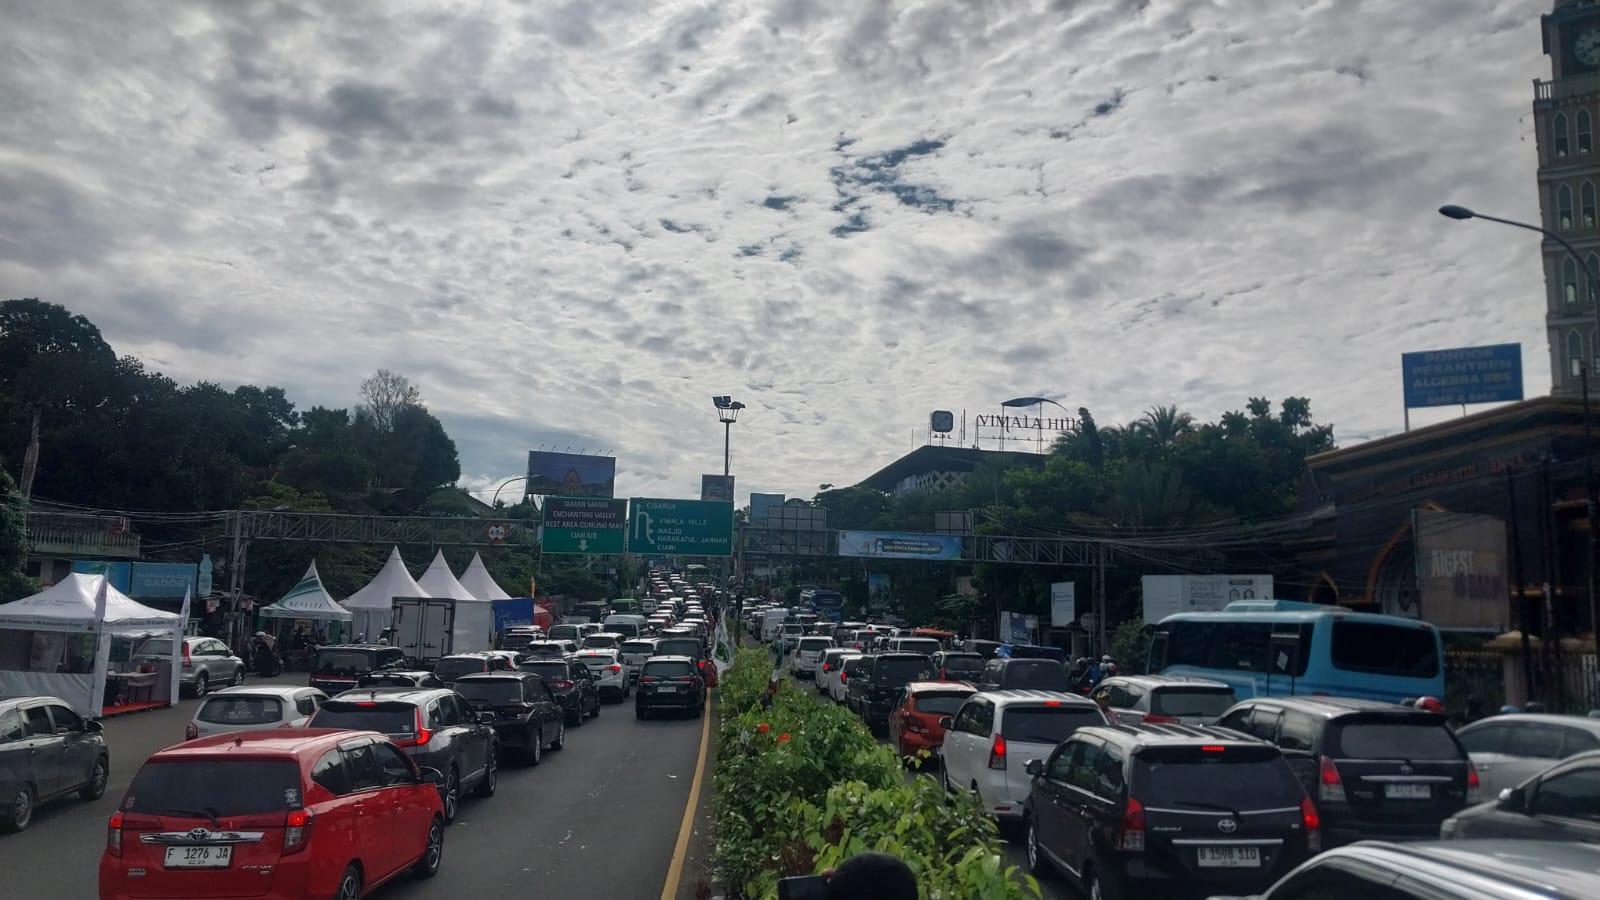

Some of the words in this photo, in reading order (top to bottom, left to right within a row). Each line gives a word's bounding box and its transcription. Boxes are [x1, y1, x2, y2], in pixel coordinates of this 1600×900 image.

[1412, 360, 1512, 375] PESANTREN
[1413, 374, 1480, 388] ALGEBRA
[552, 510, 593, 518] ENCHANTING
[594, 511, 617, 519] VALLEY
[579, 521, 608, 529] GUNUNG
[570, 531, 598, 539] CIANJUR
[658, 527, 682, 535] MASJID
[700, 537, 728, 545] JANNAH
[143, 578, 185, 587] GADOG
[168, 848, 175, 859] F
[183, 848, 209, 859] 1276
[215, 848, 229, 859] JA
